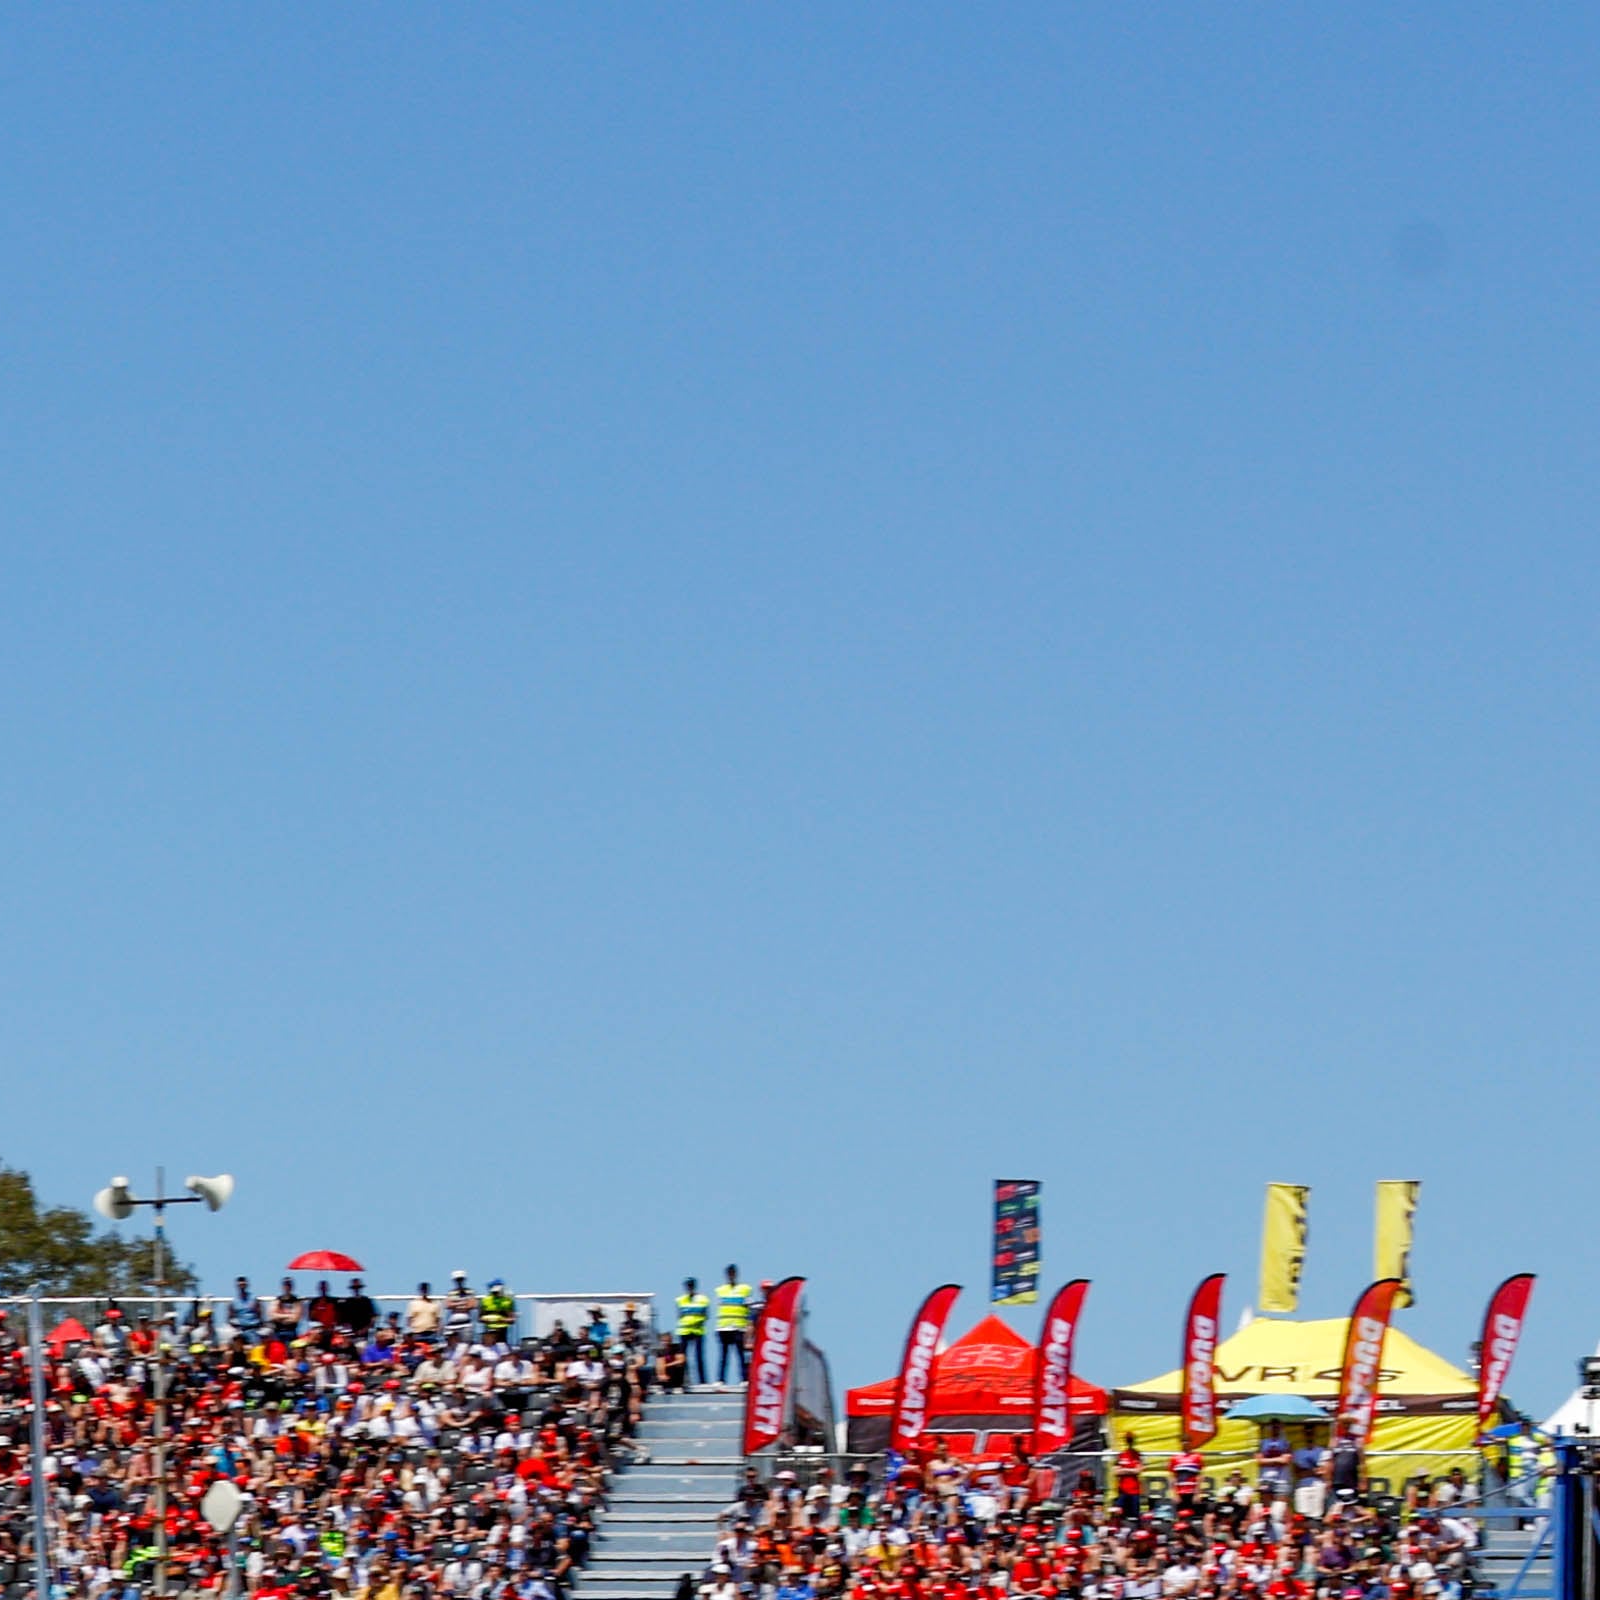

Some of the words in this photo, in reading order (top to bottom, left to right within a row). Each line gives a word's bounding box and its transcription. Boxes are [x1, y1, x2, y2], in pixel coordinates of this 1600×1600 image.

[753, 1317, 791, 1435] DUCATI
[899, 1321, 939, 1438] DUCATI
[1039, 1318, 1072, 1437] DUCATI
[1188, 1315, 1216, 1433] DUCATI
